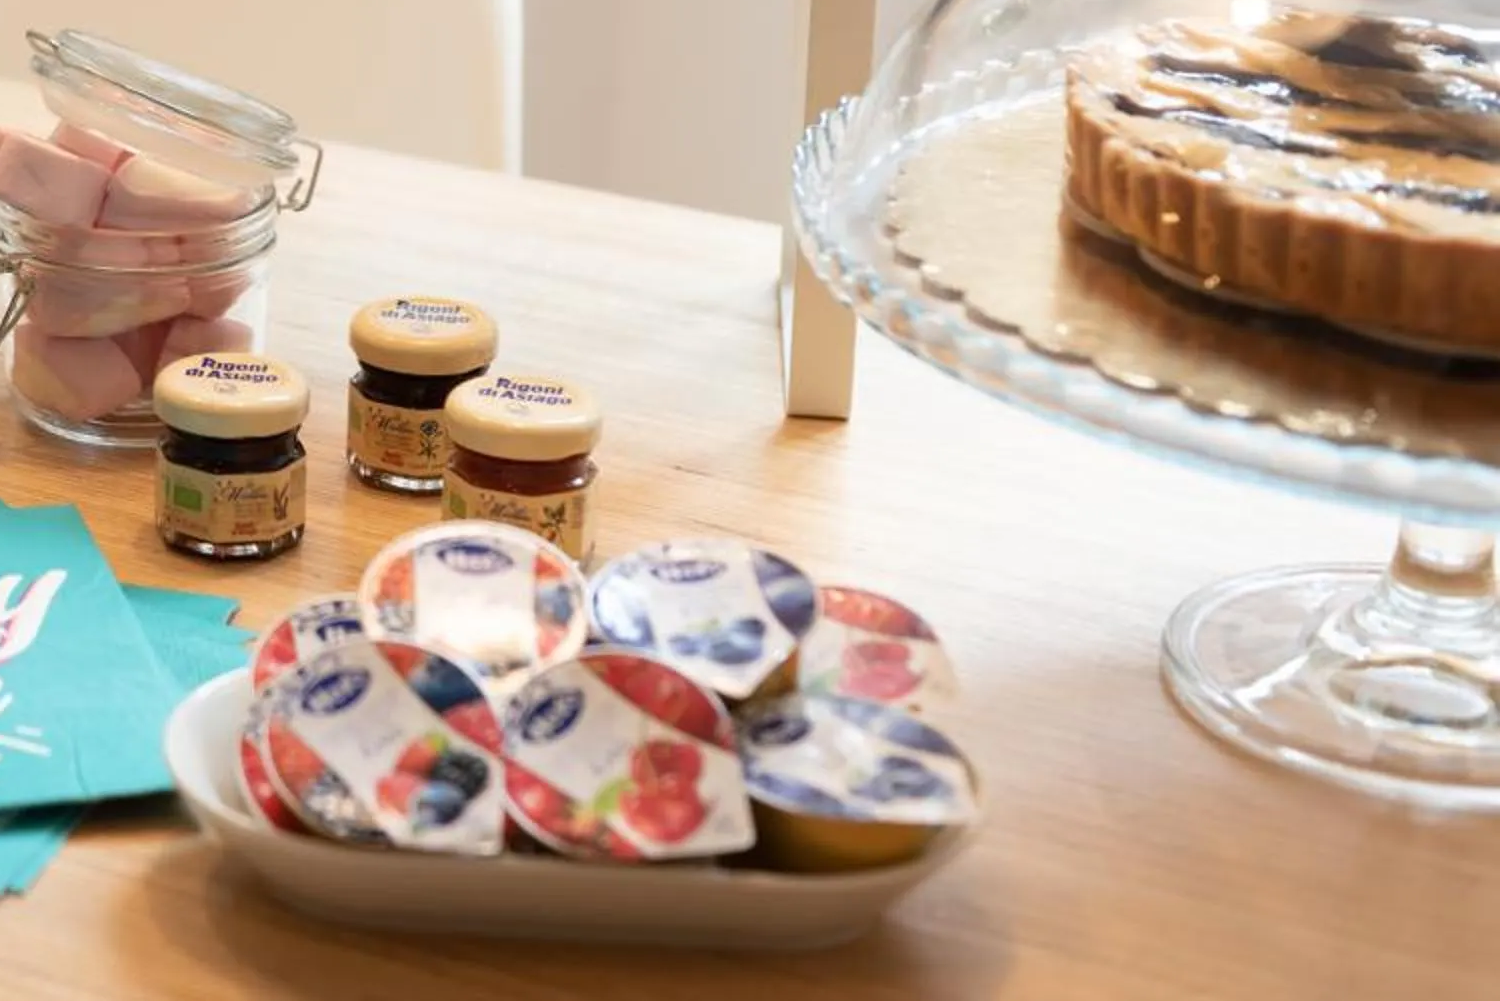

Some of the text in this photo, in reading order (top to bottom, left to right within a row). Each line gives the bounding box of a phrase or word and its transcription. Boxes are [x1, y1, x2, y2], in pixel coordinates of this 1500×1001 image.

[201, 356, 269, 372] Rigoni
[207, 369, 278, 384] Asiago
[495, 377, 564, 395] Rigoni
[500, 389, 573, 406] Asiago
